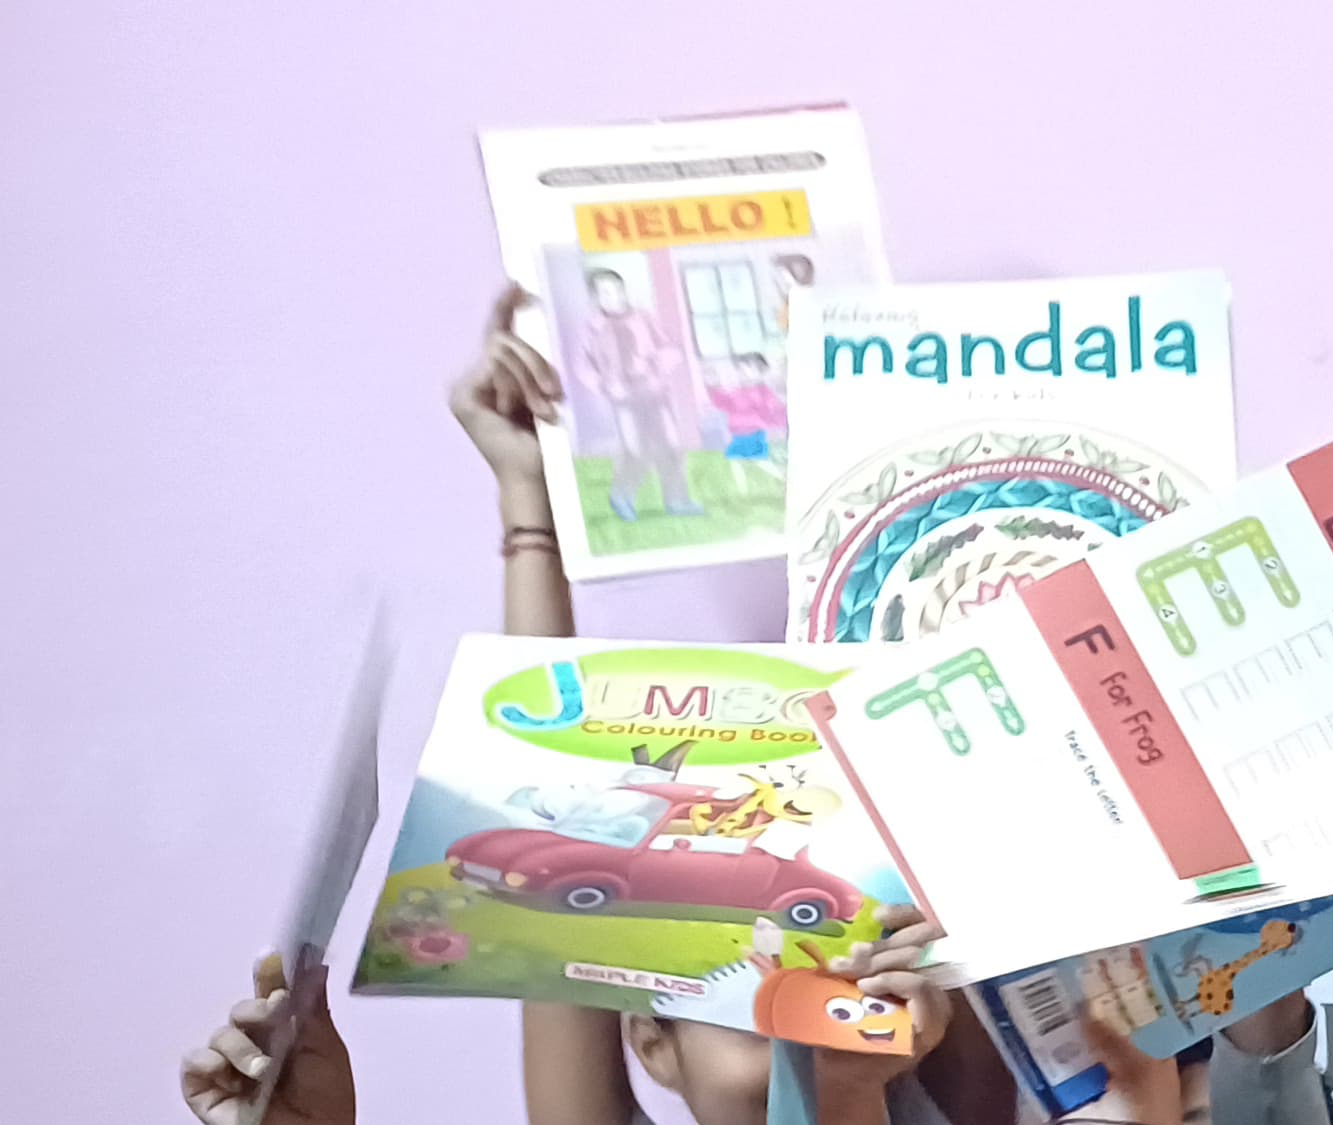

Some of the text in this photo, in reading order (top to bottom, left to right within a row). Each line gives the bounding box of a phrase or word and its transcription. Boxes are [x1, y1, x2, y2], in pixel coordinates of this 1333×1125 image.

[592, 201, 764, 243] HELLO
[824, 296, 1197, 384] mandala
[1064, 624, 1165, 766] F for Frog
[581, 720, 737, 742] Colouring
